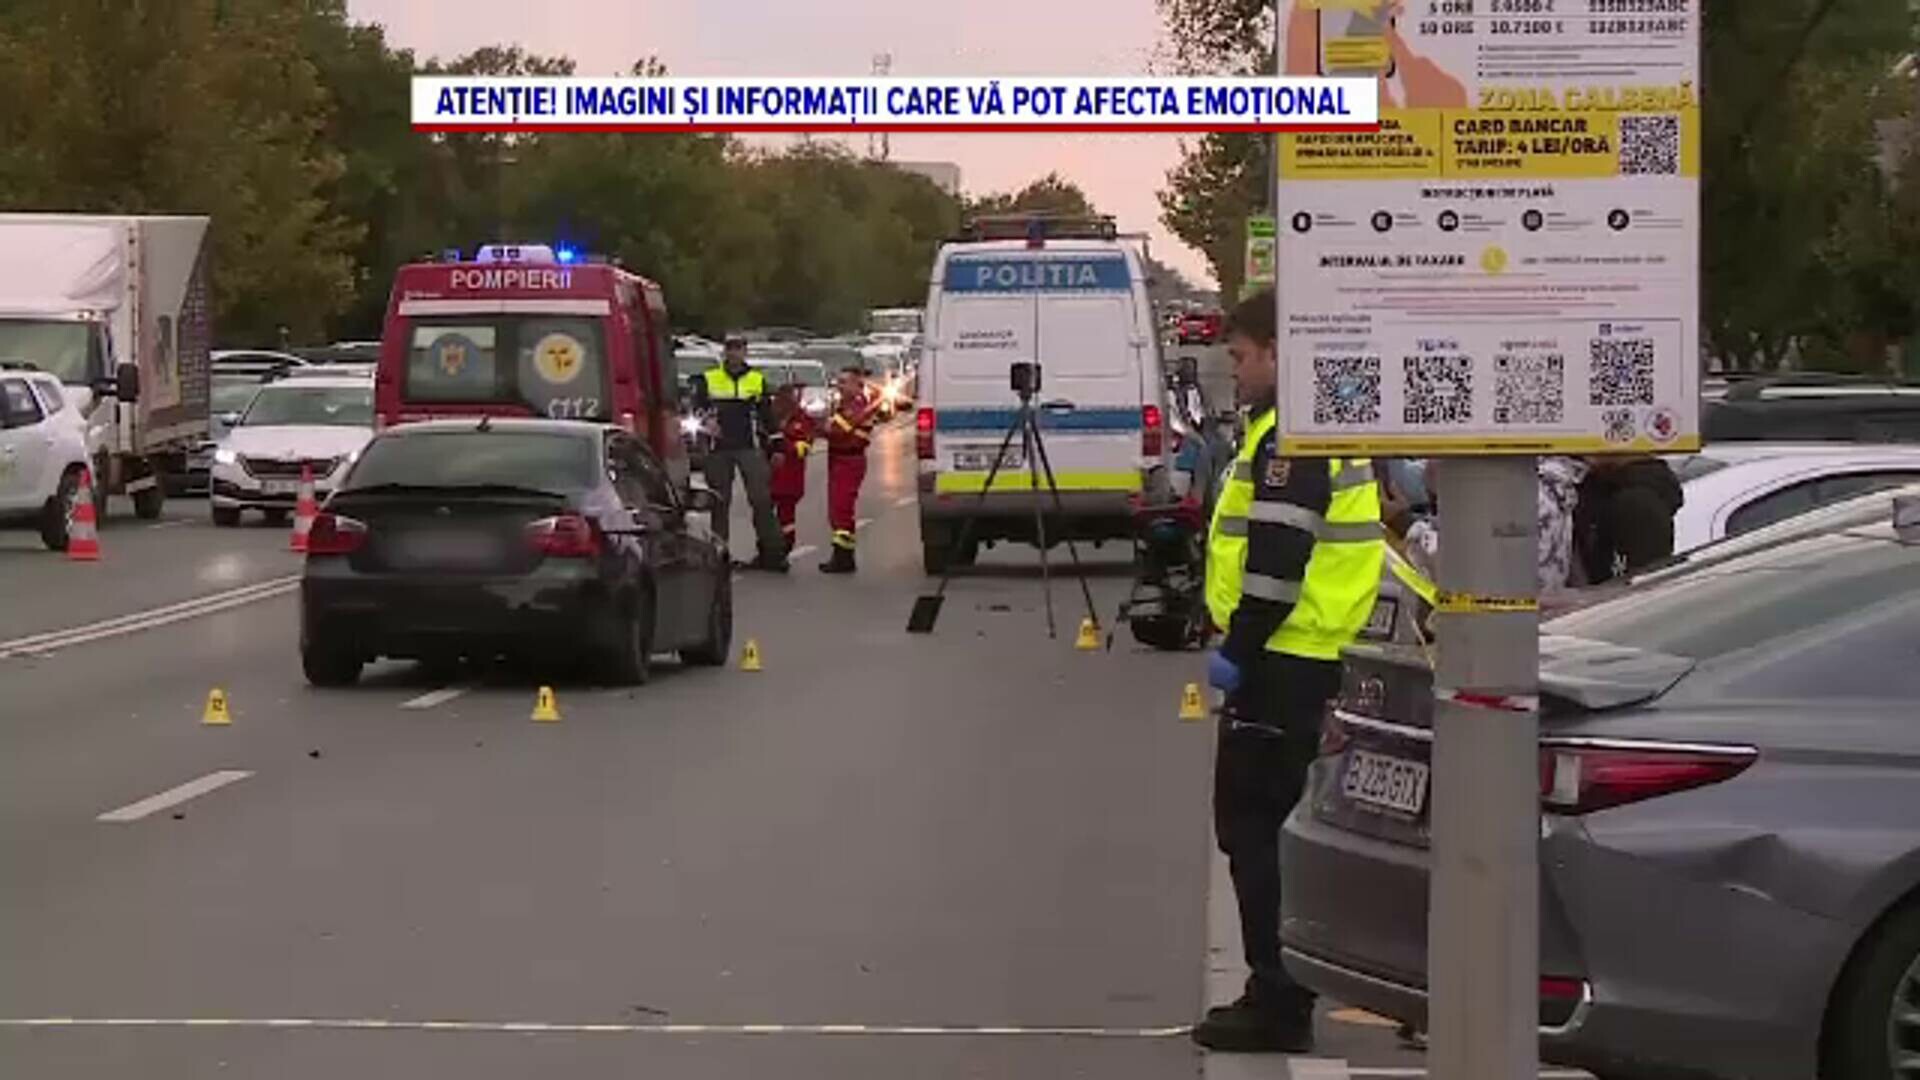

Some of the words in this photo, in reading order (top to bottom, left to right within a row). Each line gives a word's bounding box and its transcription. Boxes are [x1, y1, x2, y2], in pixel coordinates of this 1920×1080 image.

[1419, 20, 1438, 34] 10
[1442, 20, 1474, 34] ORE
[1479, 87, 1561, 111] ZONA
[1454, 119, 1506, 135] CARD
[1509, 119, 1588, 133] BANCAR
[1454, 138, 1513, 155] TARIF:
[1517, 140, 1529, 154] 4
[1532, 133, 1610, 155] LEI/ORĂ
[451, 269, 572, 290] POMPIERII
